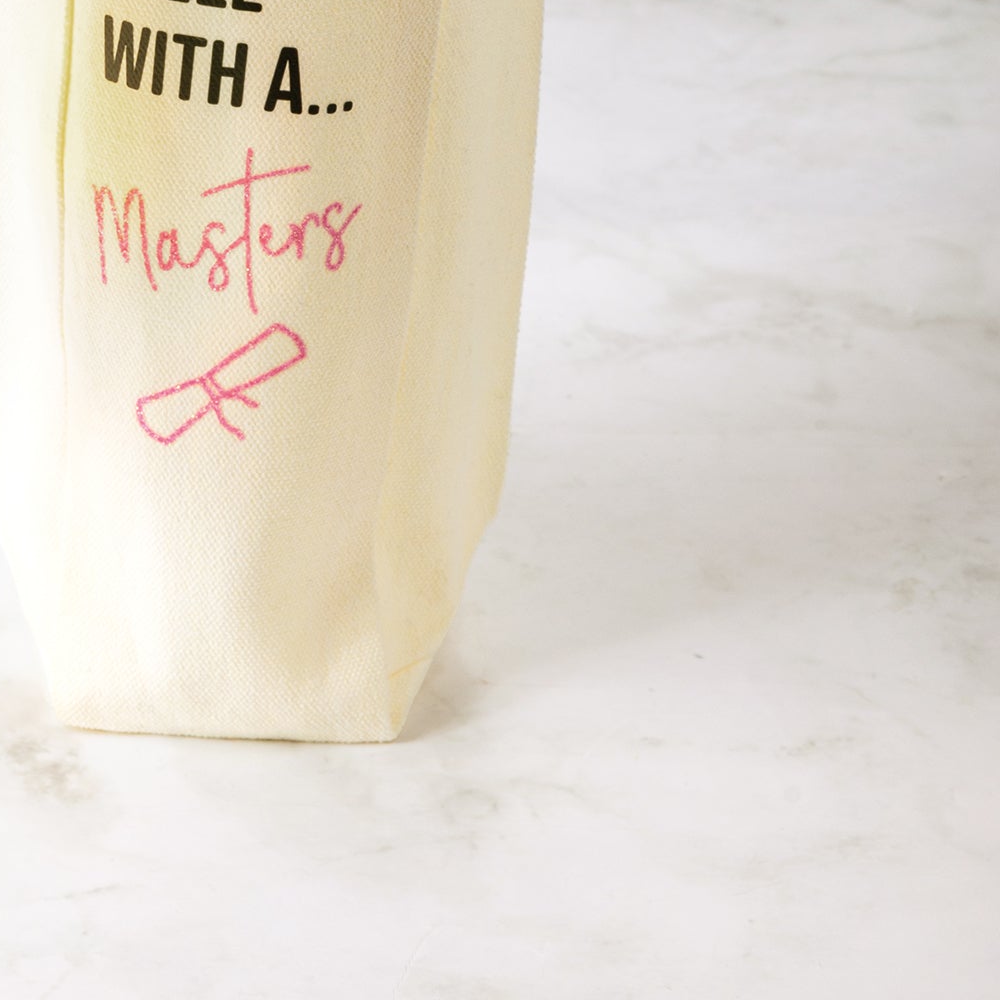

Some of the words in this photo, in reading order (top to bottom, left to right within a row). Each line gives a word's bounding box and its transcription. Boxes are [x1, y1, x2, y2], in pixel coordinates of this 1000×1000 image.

[103, 15, 250, 109] WITH
[263, 46, 354, 116] A...
[91, 146, 363, 315] Masters
